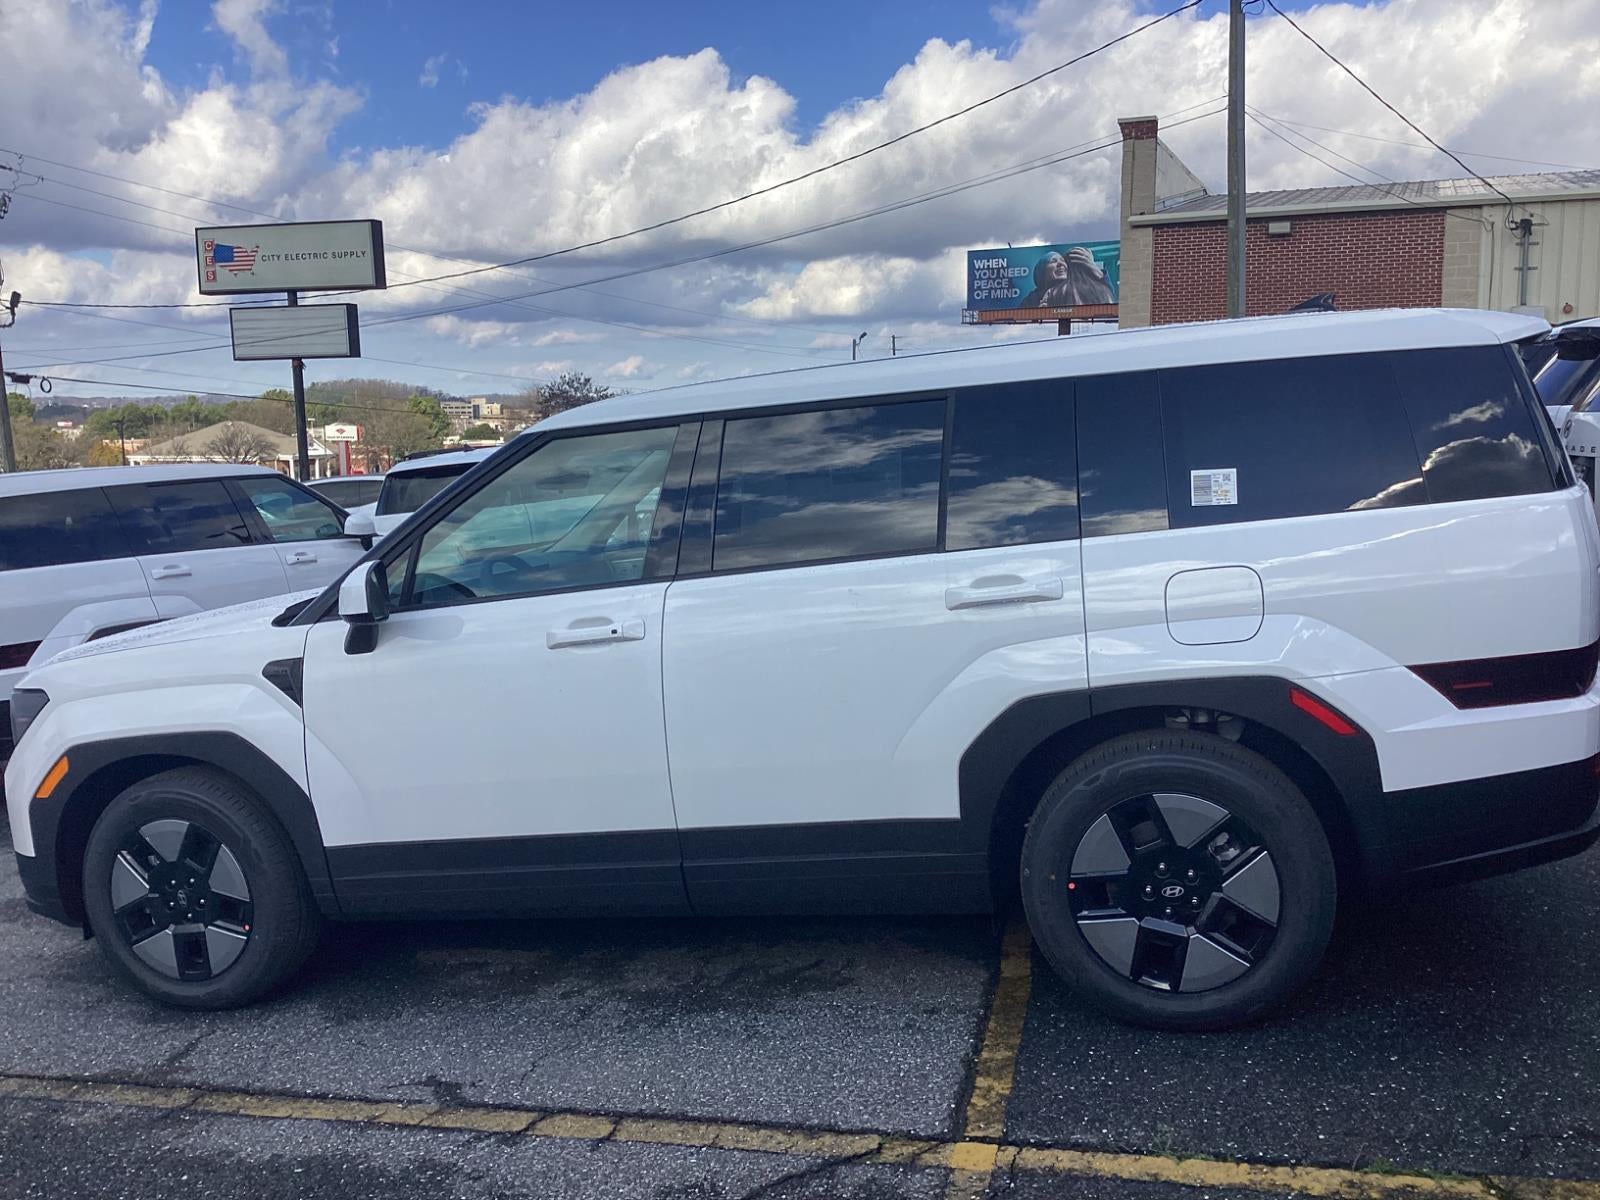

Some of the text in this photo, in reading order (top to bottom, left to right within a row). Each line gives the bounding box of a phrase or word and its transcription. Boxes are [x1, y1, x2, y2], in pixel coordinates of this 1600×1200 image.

[261, 250, 366, 262] CITY ELECTRIC SUPPLY
[974, 258, 1007, 269] WHEN
[974, 267, 1029, 279] YOU NEED
[974, 279, 1009, 289] PEACE
[974, 289, 1020, 300] OF MIND
